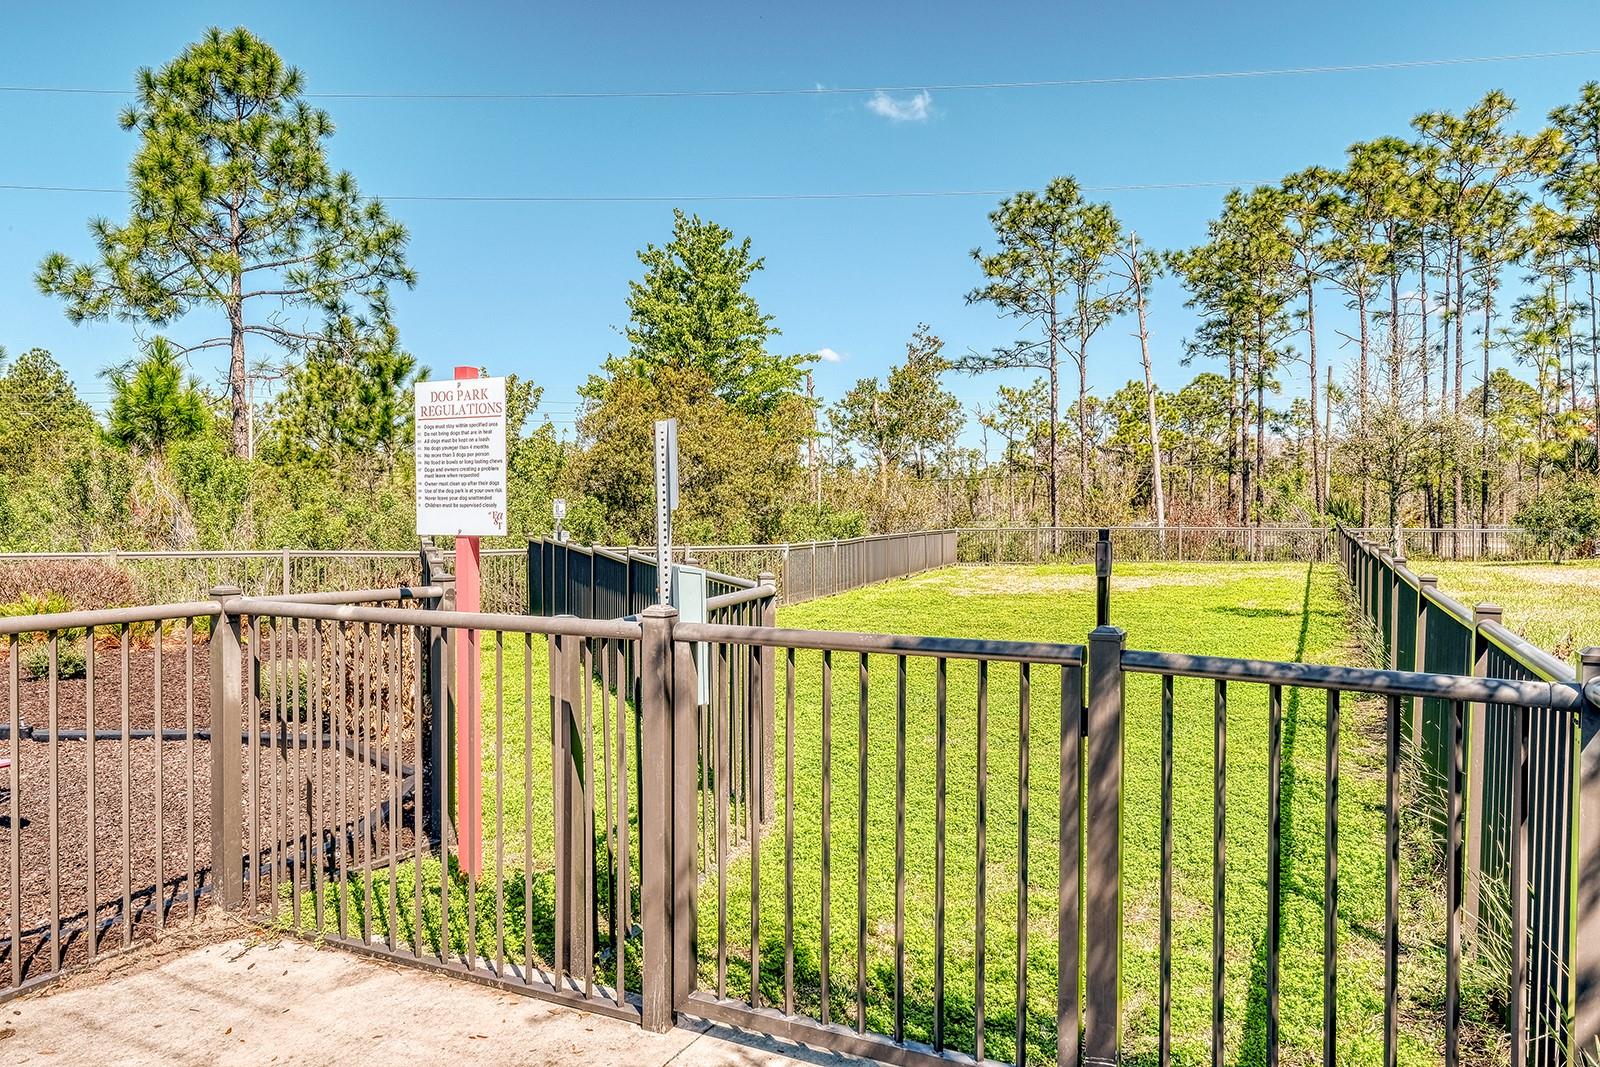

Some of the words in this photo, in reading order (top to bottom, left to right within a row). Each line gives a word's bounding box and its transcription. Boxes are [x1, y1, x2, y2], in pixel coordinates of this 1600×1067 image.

[431, 391, 453, 402] DOG
[457, 388, 488, 400] PARK
[421, 402, 502, 417] REGULATIONS
